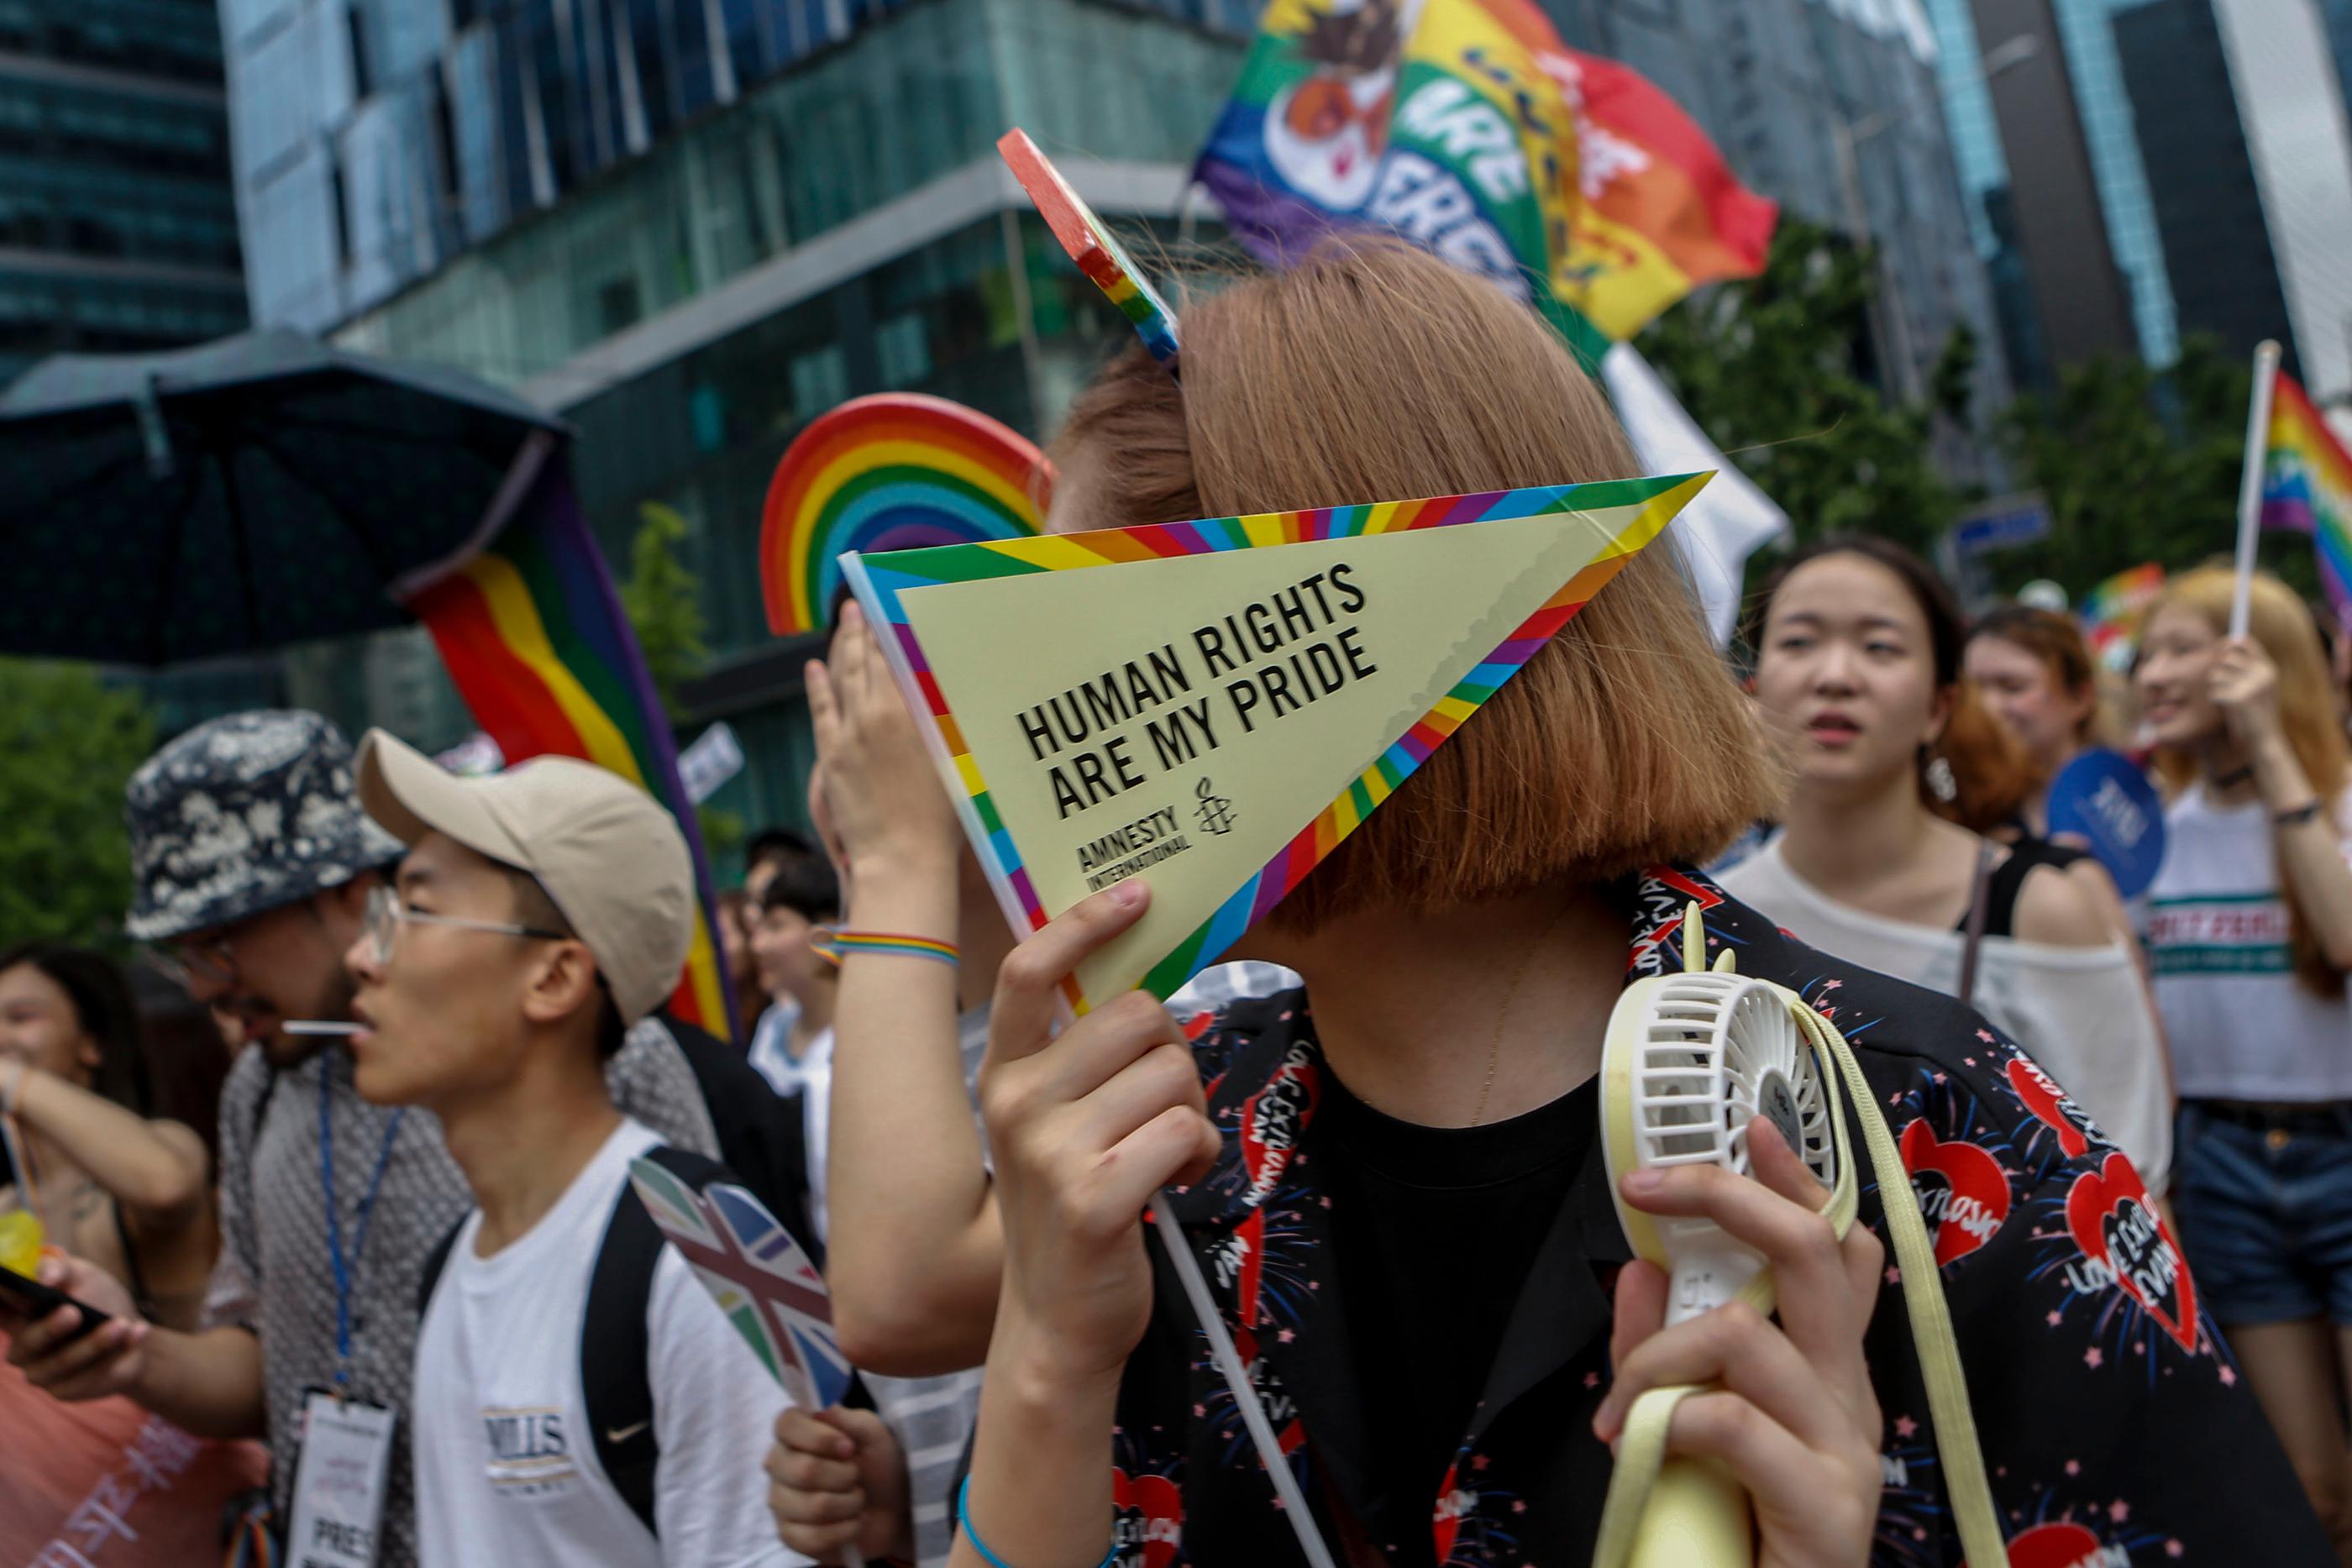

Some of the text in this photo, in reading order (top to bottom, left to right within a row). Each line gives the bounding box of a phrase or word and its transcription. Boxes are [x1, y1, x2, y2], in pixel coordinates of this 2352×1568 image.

[1015, 563, 1367, 761] HUMAN RIGHTS
[1048, 627, 1378, 820] ARE MY PRIDE
[1076, 805, 1178, 873] AMNESTY
[1085, 835, 1193, 893] INTERNATIONAL
[2064, 1232, 2132, 1294] LOVE
